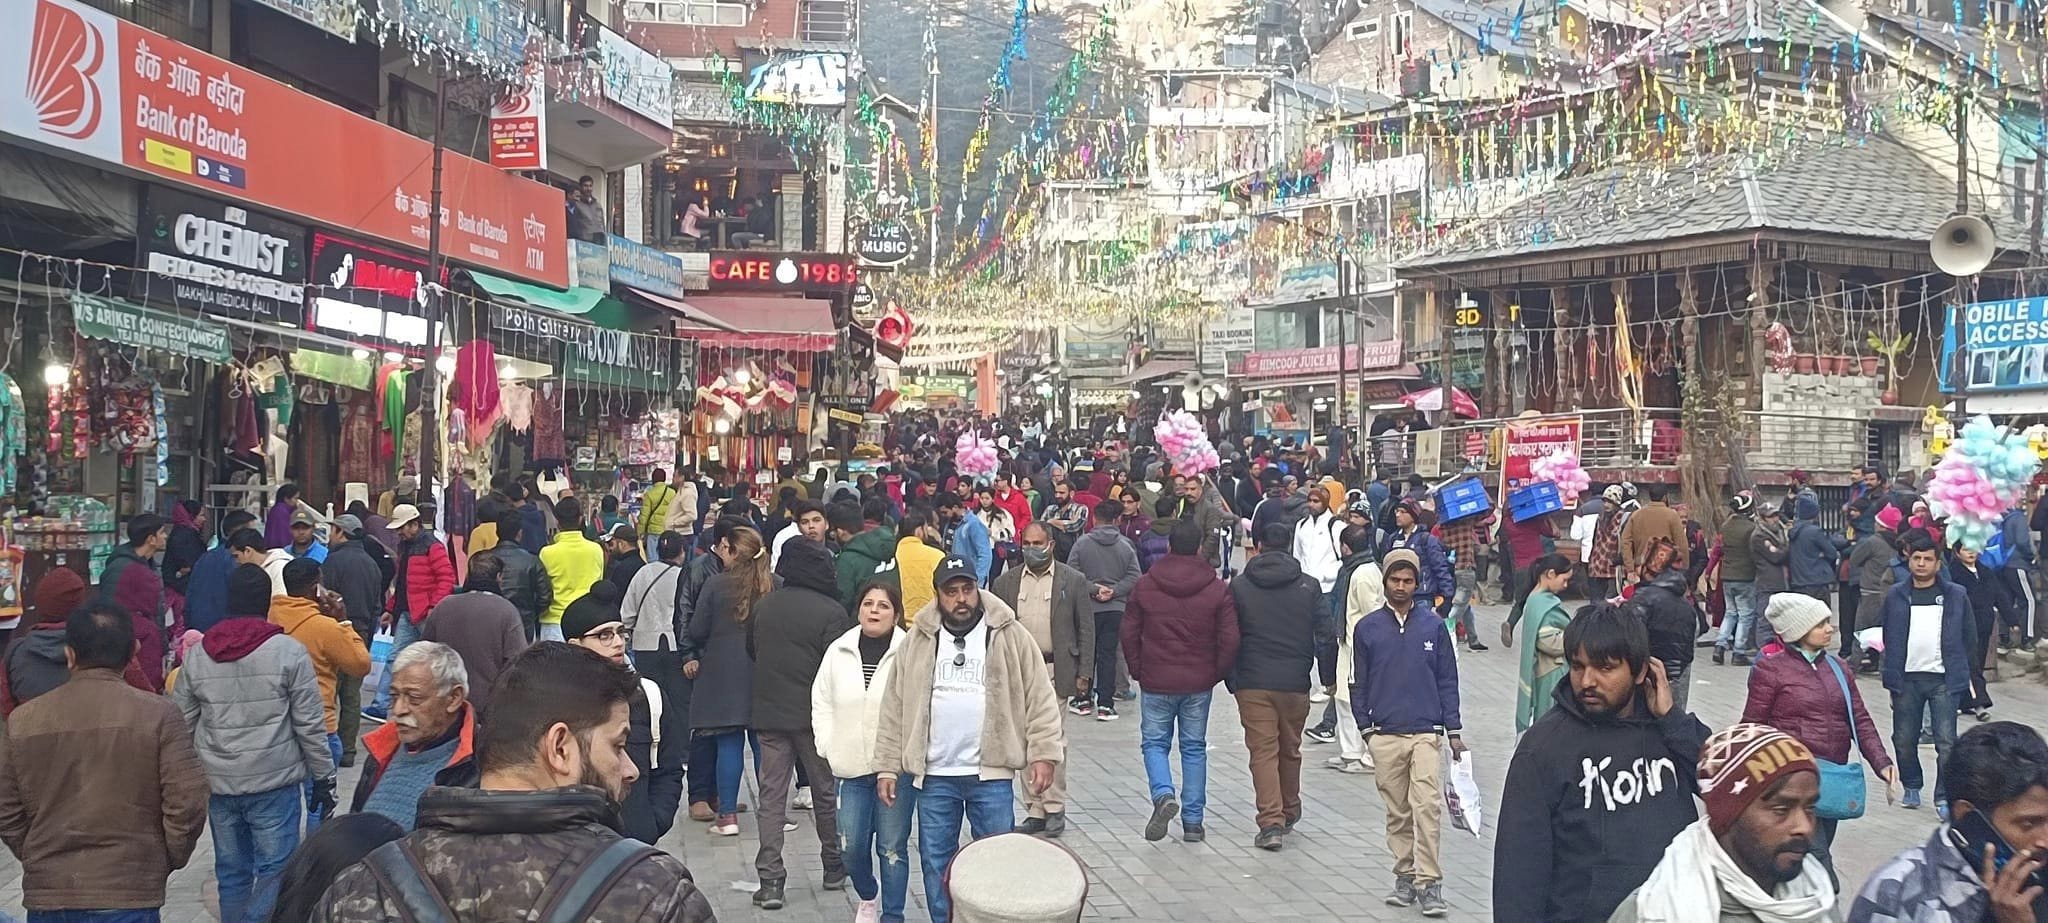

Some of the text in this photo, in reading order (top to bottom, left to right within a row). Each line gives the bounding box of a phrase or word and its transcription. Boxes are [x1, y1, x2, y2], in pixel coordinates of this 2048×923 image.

[135, 38, 162, 82] बैंक
[206, 71, 246, 116] बड़ौदा
[136, 94, 178, 138] Bank
[178, 112, 196, 143] of
[196, 114, 247, 161] Baroda
[457, 210, 476, 235] Bank
[476, 217, 484, 238] of
[484, 220, 508, 244] Baroda
[522, 212, 546, 244] एटीएम
[868, 224, 900, 238] LIVE
[174, 213, 289, 276] CHEMIST
[607, 235, 631, 268] Hotel
[861, 241, 907, 254] MUSIC
[526, 247, 544, 272] ATM
[710, 260, 771, 281] CAFE
[216, 291, 250, 311] MEDICAL
[1455, 308, 1481, 326] 3D
[96, 307, 137, 331] ARIKET
[138, 316, 226, 351] CONFECTIONERY
[117, 328, 133, 342] TEJ
[152, 335, 168, 348] AND
[1364, 345, 1399, 356] FRUIT
[1259, 356, 1298, 371] HIMCOOP
[1299, 354, 1325, 370] JUICE
